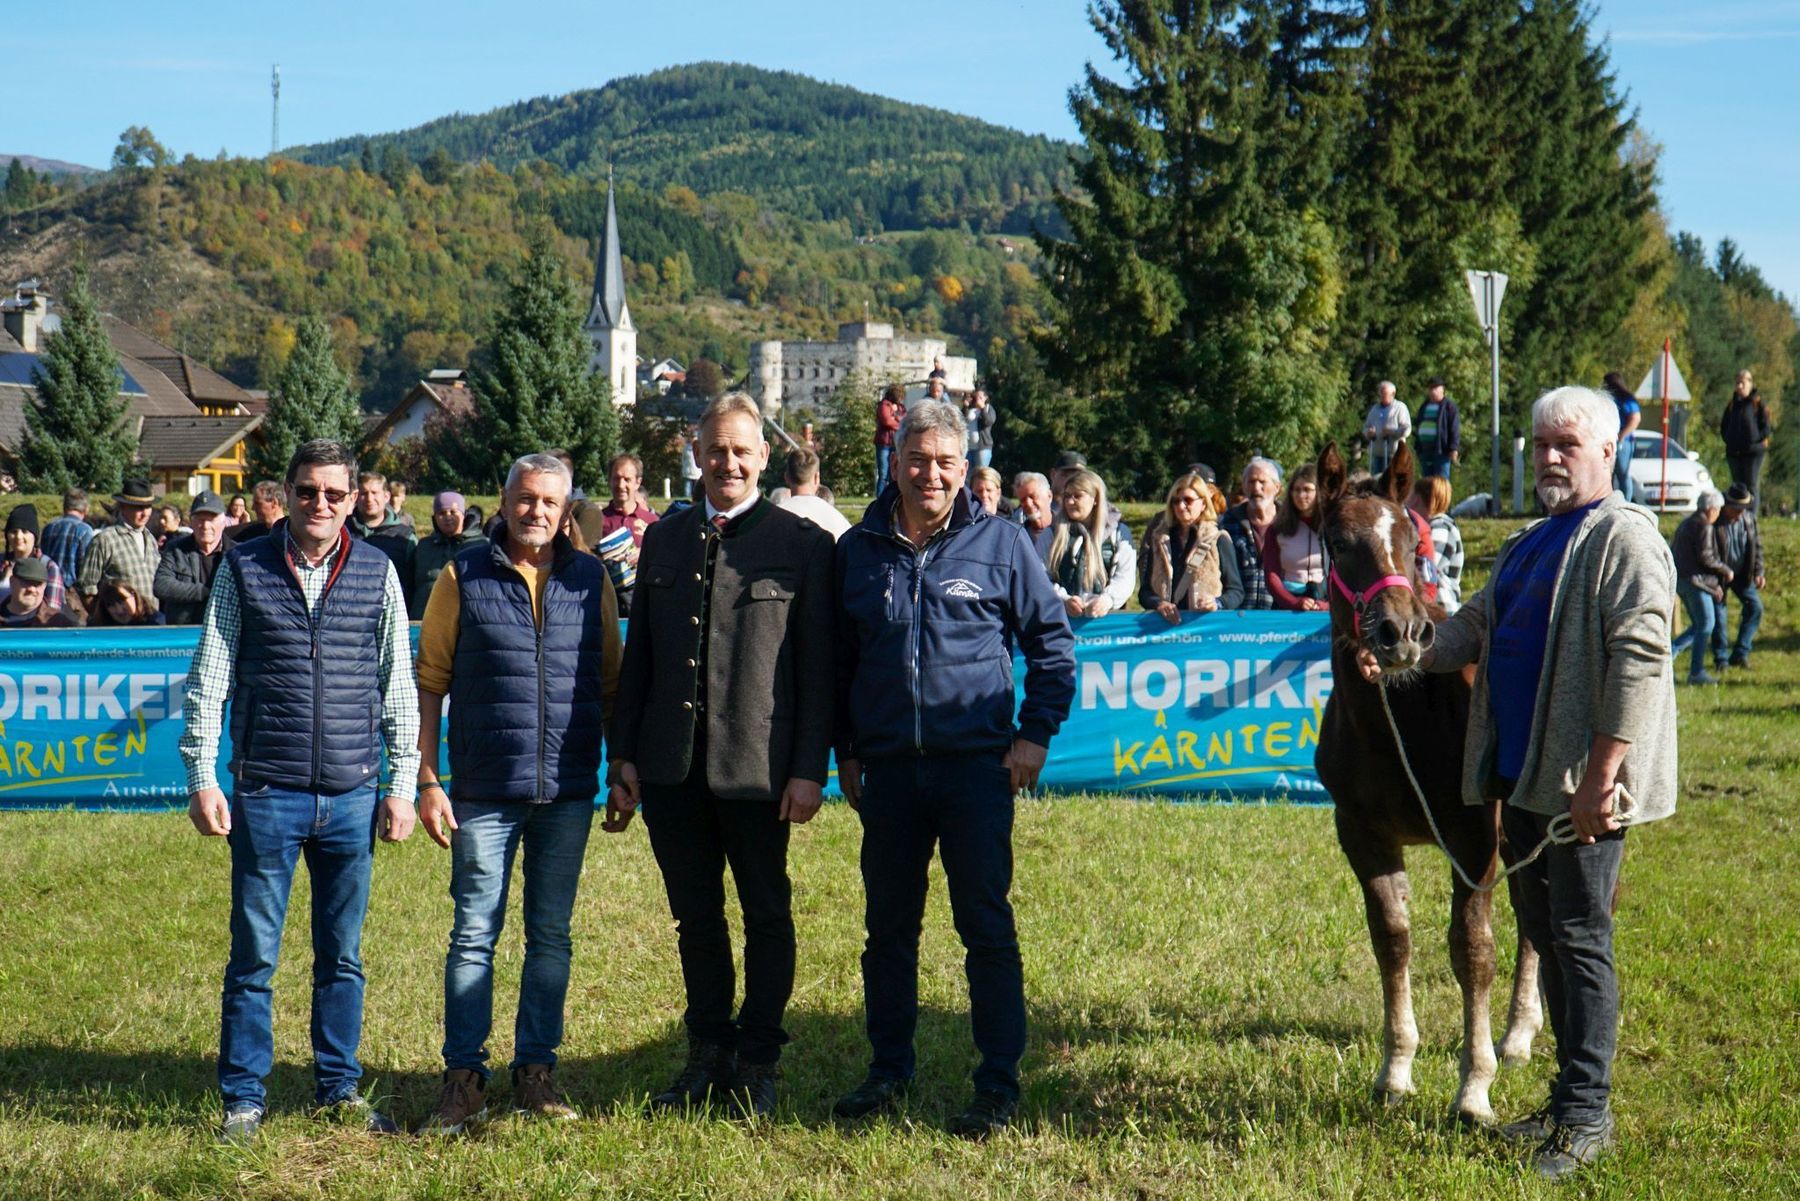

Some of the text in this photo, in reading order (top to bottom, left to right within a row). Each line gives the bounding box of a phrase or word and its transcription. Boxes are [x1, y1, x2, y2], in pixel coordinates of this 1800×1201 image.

[1074, 634, 1112, 646] tvoll
[1116, 634, 1148, 646] und
[1151, 631, 1203, 645] schön
[103, 781, 188, 797] Austria
